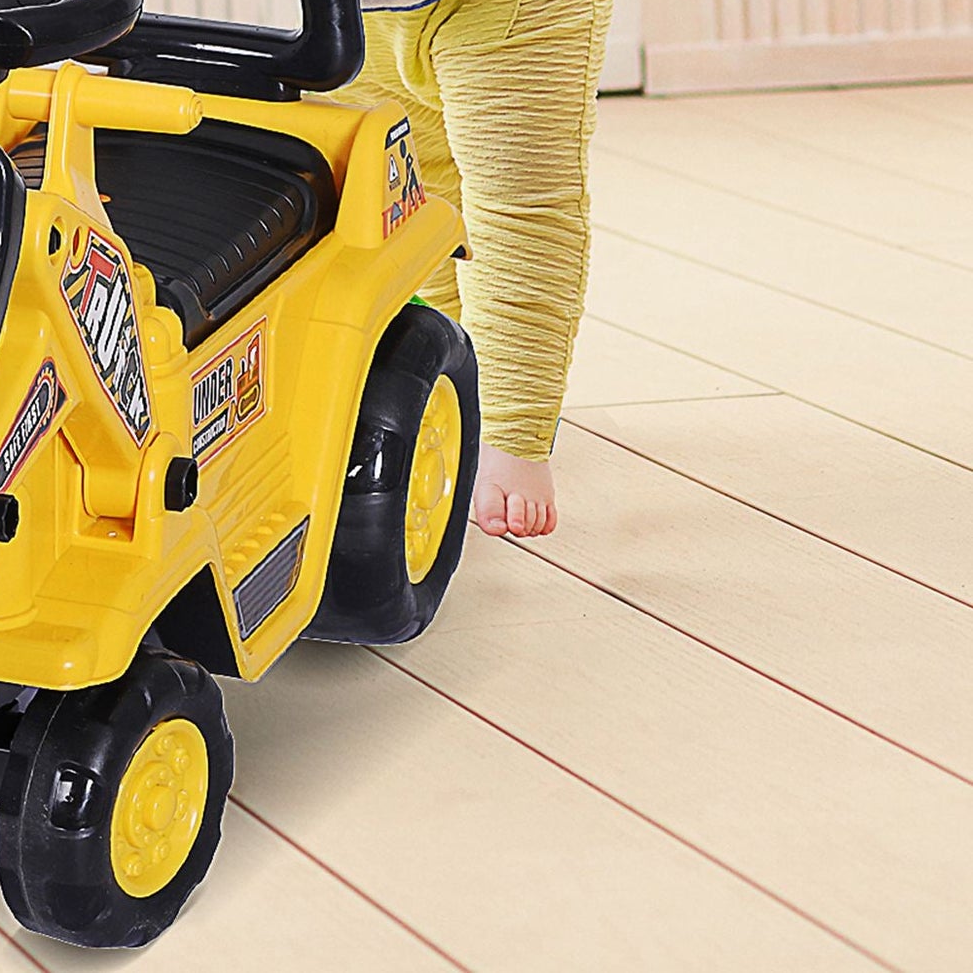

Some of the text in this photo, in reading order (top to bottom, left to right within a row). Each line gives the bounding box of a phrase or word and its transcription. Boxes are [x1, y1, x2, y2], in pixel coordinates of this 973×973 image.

[194, 359, 233, 425] UNDER
[21, 397, 41, 443] FIRST
[193, 414, 226, 455] CONSTRUCTION
